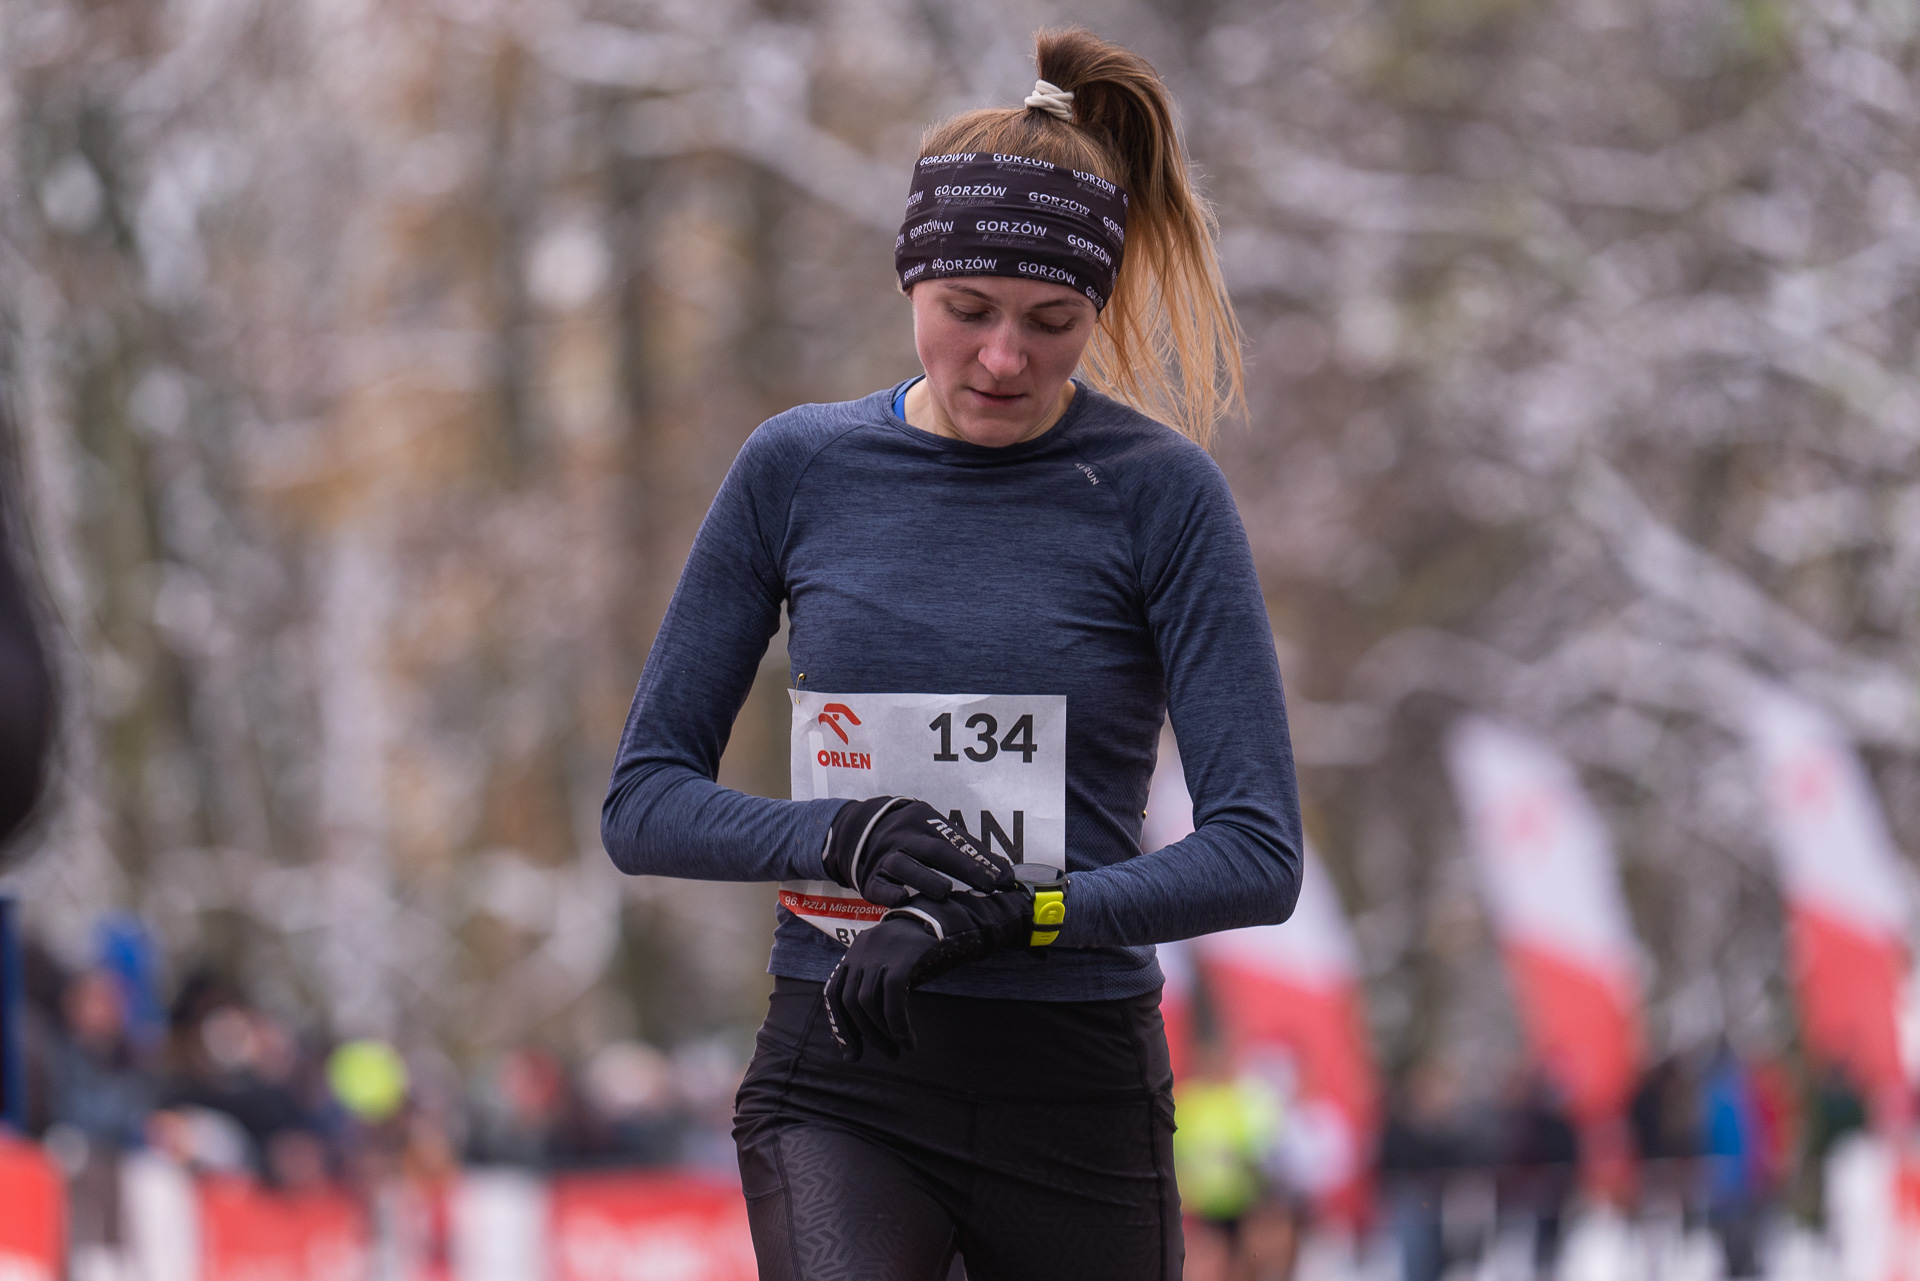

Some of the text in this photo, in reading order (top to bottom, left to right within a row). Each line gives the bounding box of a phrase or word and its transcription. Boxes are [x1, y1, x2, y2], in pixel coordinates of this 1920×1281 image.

[1028, 191, 1090, 216] GORZÓW
[975, 220, 1048, 236] GORZÓW
[1067, 234, 1112, 267] GORZÓW
[1018, 261, 1076, 285] GORZÓW
[928, 712, 1038, 763] 134
[817, 750, 871, 770] ORLEN
[785, 895, 799, 907] 96.
[802, 899, 826, 911] PZLA
